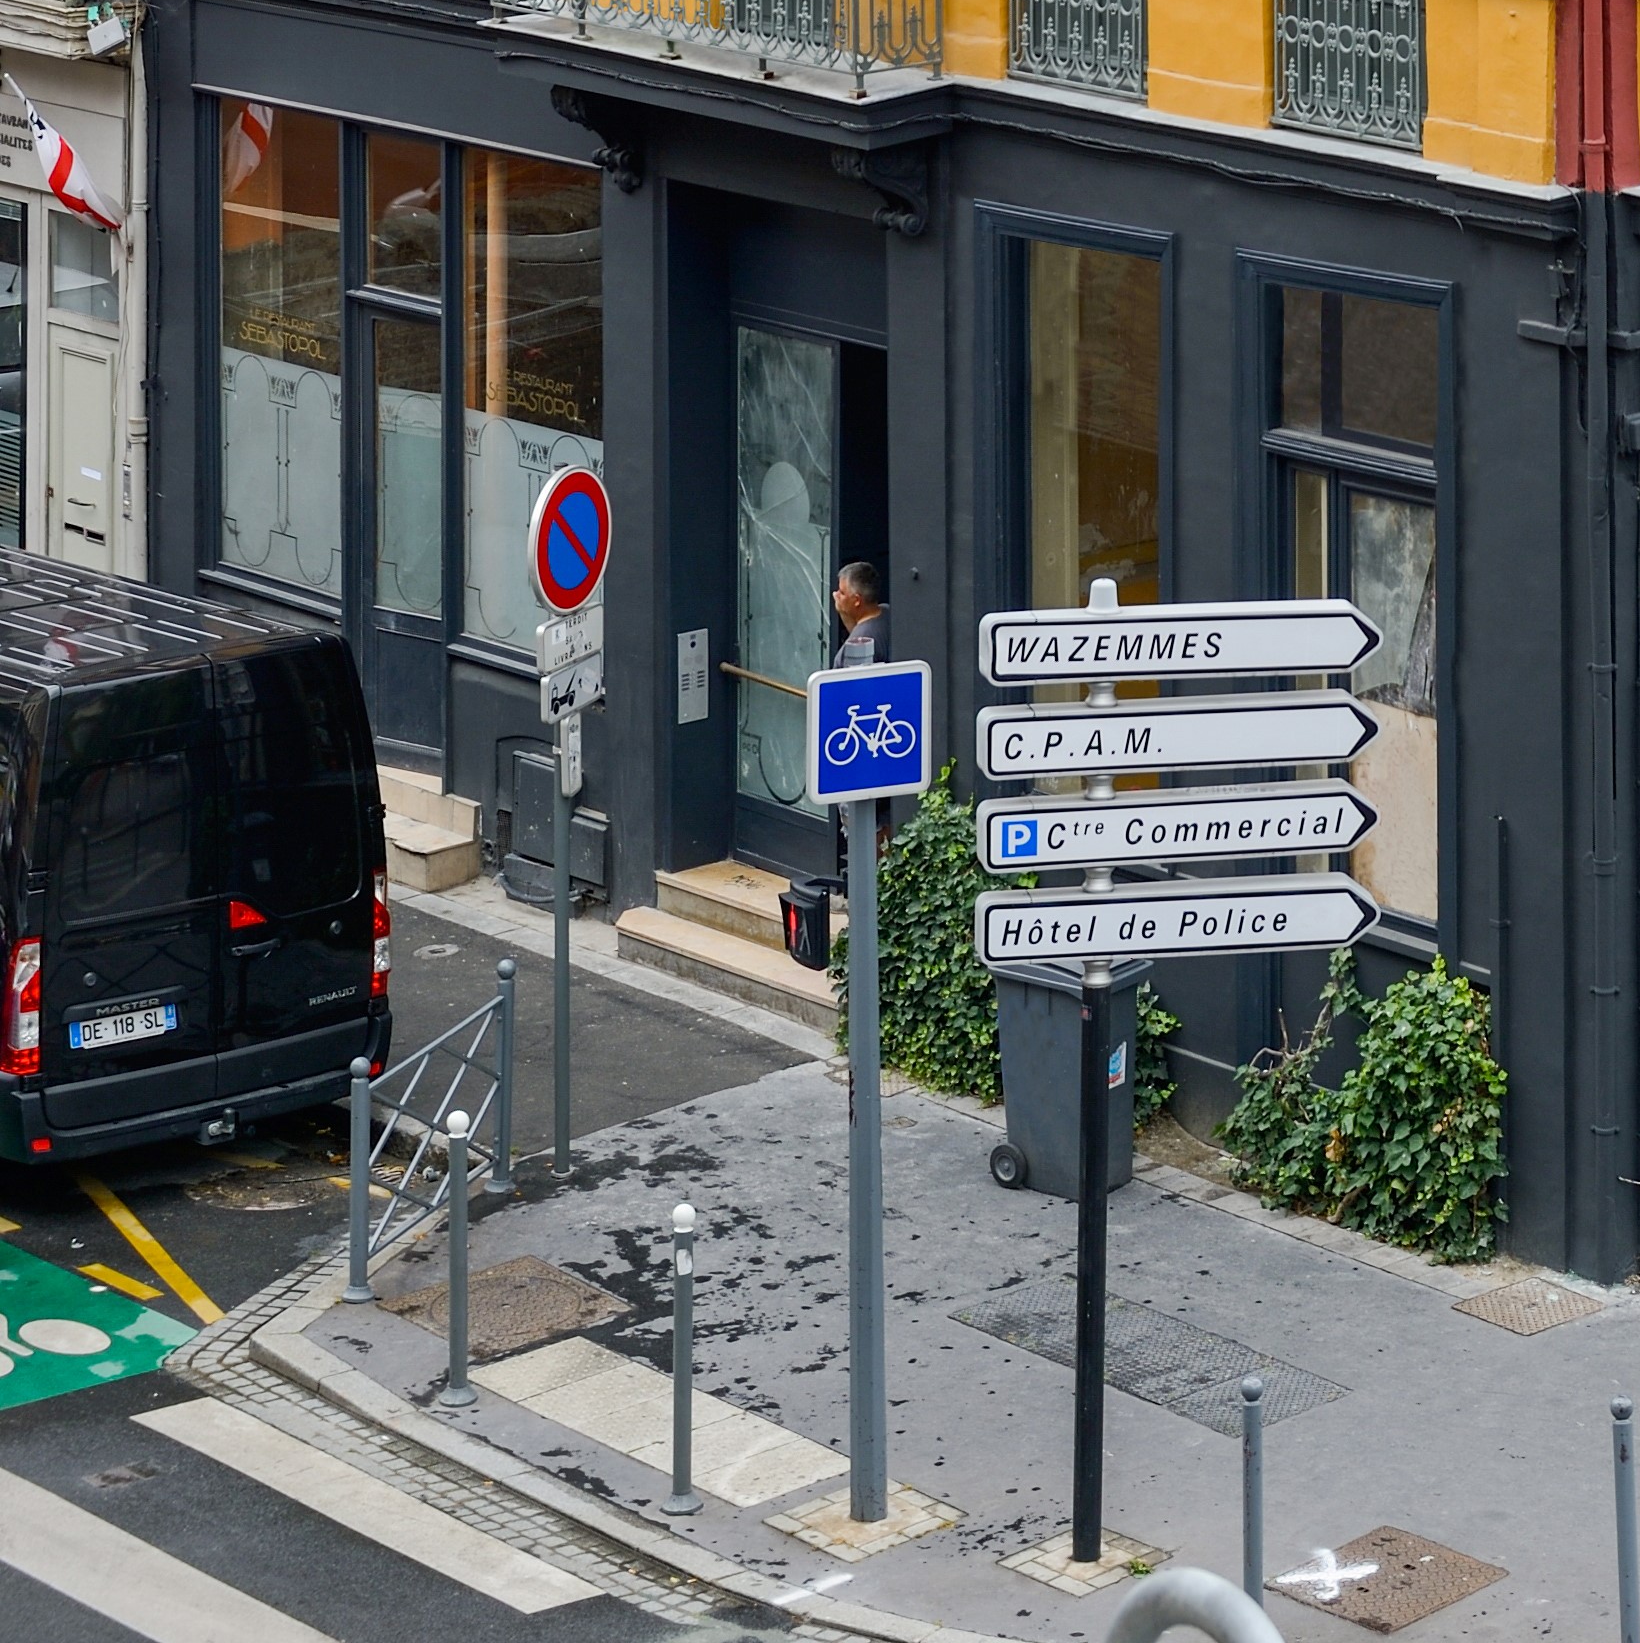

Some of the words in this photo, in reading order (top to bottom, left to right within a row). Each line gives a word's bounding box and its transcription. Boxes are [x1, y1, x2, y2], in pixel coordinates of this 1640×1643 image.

[239, 321, 326, 360] SEBASTOPOL
[514, 371, 574, 395] RESTAURANT
[487, 381, 586, 423] SEBASTOPOL
[565, 612, 588, 629] TERDIT
[1007, 632, 1223, 663] WAZEMMES
[1004, 727, 1163, 760] C.P.A.M.
[1047, 820, 1104, 850] Ctre
[1125, 808, 1344, 845] Commercial
[1001, 915, 1097, 947] Hôtel
[1119, 913, 1157, 940] de
[1179, 908, 1288, 937] Police
[96, 996, 160, 1017] MASTER
[308, 983, 357, 1007] RENAULT
